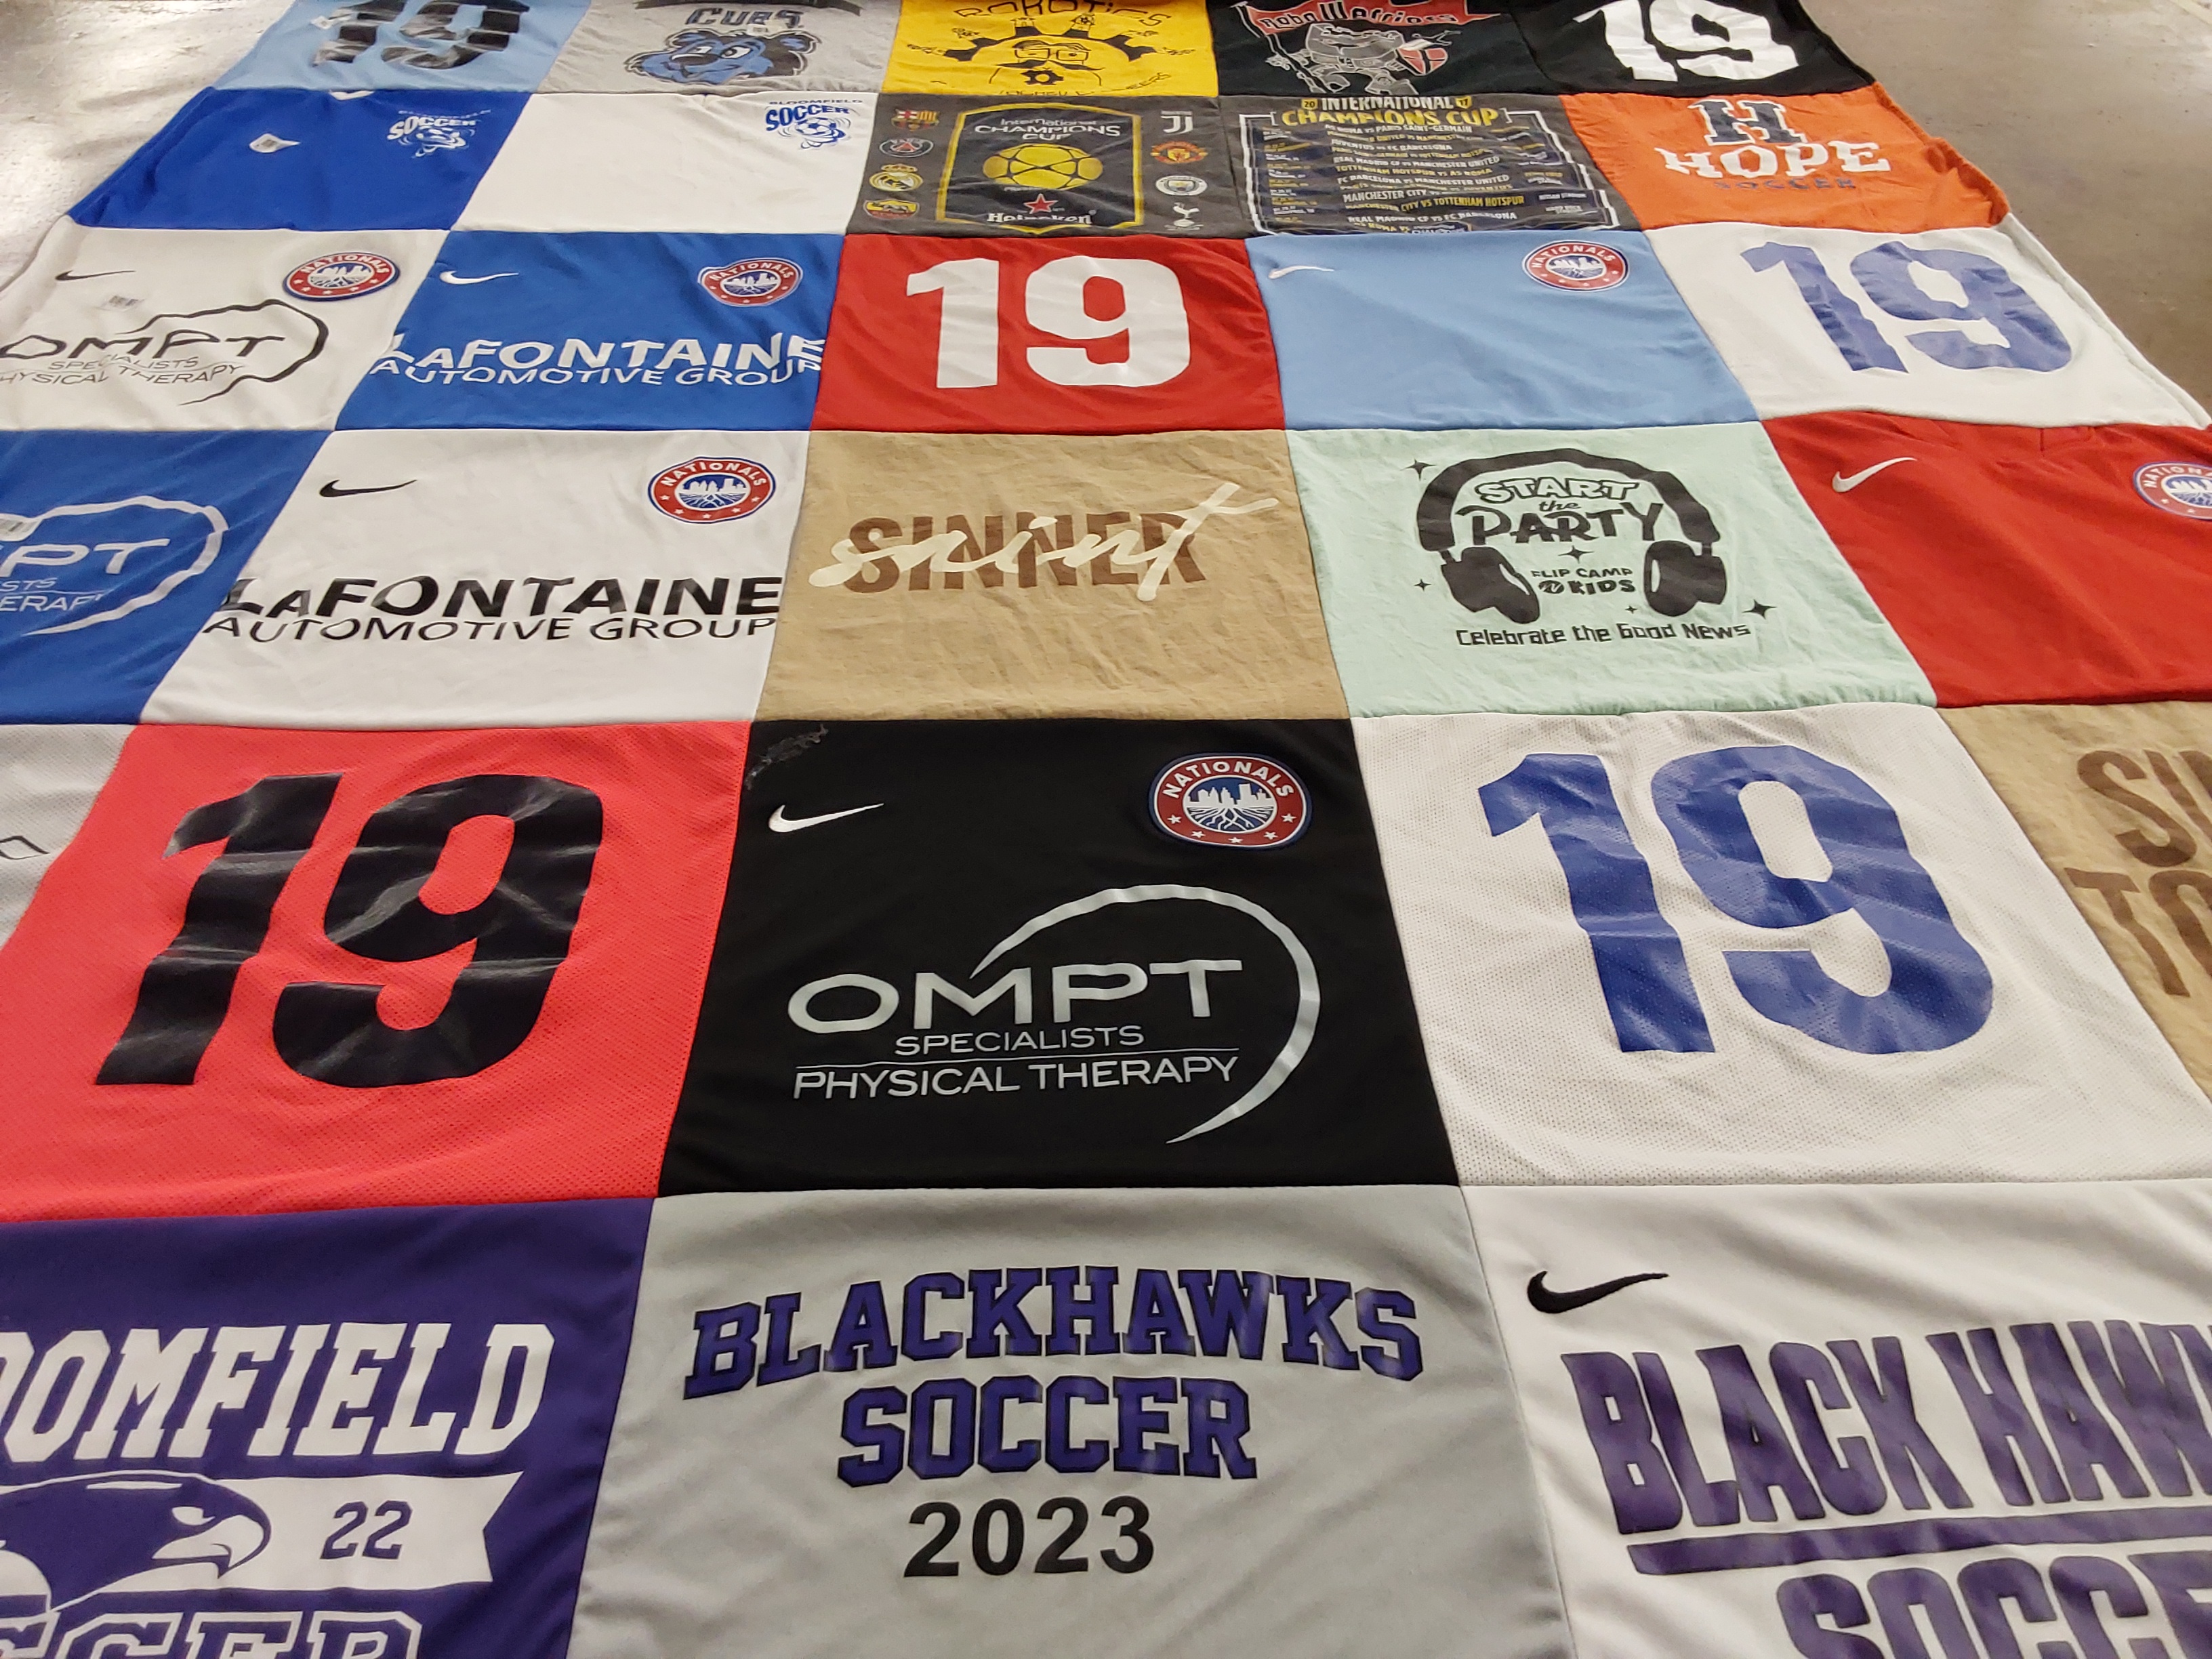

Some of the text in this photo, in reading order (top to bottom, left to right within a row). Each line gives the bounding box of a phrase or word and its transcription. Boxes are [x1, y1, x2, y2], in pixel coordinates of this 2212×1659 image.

[1572, 0, 1799, 81] 19
[1322, 96, 1453, 110] INTERNATIONAL
[1446, 107, 1499, 126] CUP
[387, 116, 476, 140] SOCCER
[766, 104, 850, 131] SOCCER
[1282, 108, 1441, 126] CHAMPIONS
[975, 125, 1120, 137] CHAMPIONS
[1467, 156, 1500, 167] UNITED
[1654, 140, 1891, 178] HOPE
[1475, 174, 1510, 184] UNITED
[1343, 190, 1404, 203] MANCHESTER
[1406, 189, 1427, 197] CITY
[1401, 201, 1418, 212] CITY
[1433, 197, 1483, 207] TOTTENHAM
[1485, 196, 1525, 207] HOTSPUR
[300, 254, 390, 274] NATIONALS
[1531, 245, 1617, 268] NATIONALS
[710, 262, 794, 281] NATIONALS
[1740, 241, 2072, 374] 19
[906, 255, 1191, 388] 19
[0, 329, 286, 359] OMPT
[369, 359, 821, 386] AUTOMOTIVE GROUP
[660, 462, 767, 487] NATIONALS
[2142, 466, 2212, 489] NATION
[1474, 476, 1640, 504] START
[1538, 500, 1582, 512] the
[1455, 501, 1664, 546] PARTY
[0, 538, 171, 577] PT
[843, 511, 1206, 594] SINNER
[1530, 567, 1633, 578] FLIP CAMP
[1568, 579, 1637, 596] KIDS
[201, 617, 777, 643] AUTOMOTIVE GROUP
[1456, 623, 1752, 647] Celebrate the Good News
[1162, 760, 1295, 800] NATIONALS
[1477, 744, 1994, 1055] 19
[95, 773, 605, 1089] 19
[787, 959, 1243, 1034] OMPT
[894, 1024, 1145, 1057] SPECIALISTS
[792, 1055, 1240, 1100] PHYSICAL THERAPY
[682, 1265, 1425, 1401] BLACKHAWKS
[836, 1374, 1258, 1488] SOCCER
[1559, 1319, 2212, 1536] BLACK HAW
[320, 1500, 413, 1561] 22
[903, 1495, 1155, 1579] 2023
